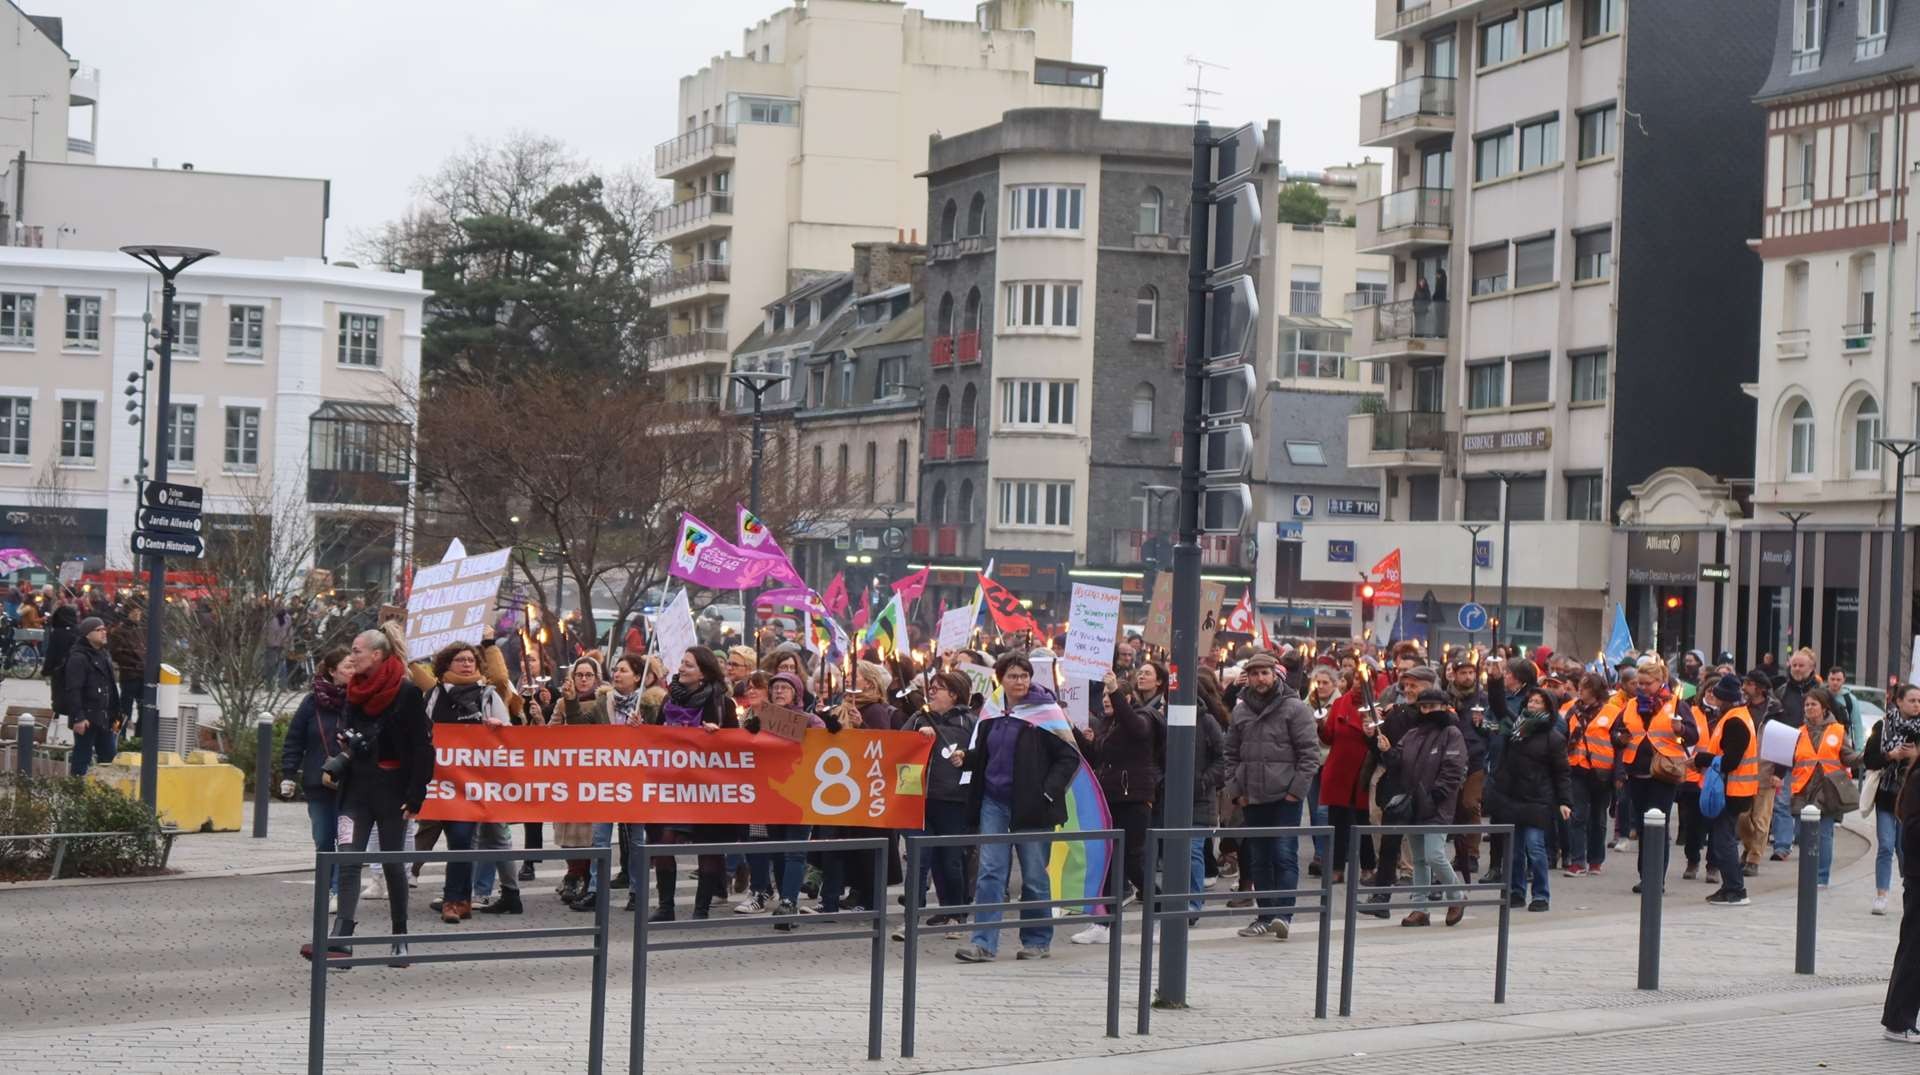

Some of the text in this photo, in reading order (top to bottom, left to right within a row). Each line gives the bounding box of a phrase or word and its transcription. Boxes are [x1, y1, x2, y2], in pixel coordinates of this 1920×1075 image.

[1464, 434, 1494, 450] RESIDENCE
[1340, 501, 1378, 513] LE TIKI
[149, 515, 169, 527] Jardin
[146, 539, 196, 554] Centre Historique
[1646, 536, 1670, 550] Allianz
[1763, 552, 1783, 562] Allianz
[1703, 569, 1723, 577] Allianz
[435, 745, 755, 768] URNÉE INTERNATIONALE
[811, 747, 861, 815] 8
[863, 739, 886, 817] MARS
[425, 779, 756, 803] ES DROITS DES FEMMES
